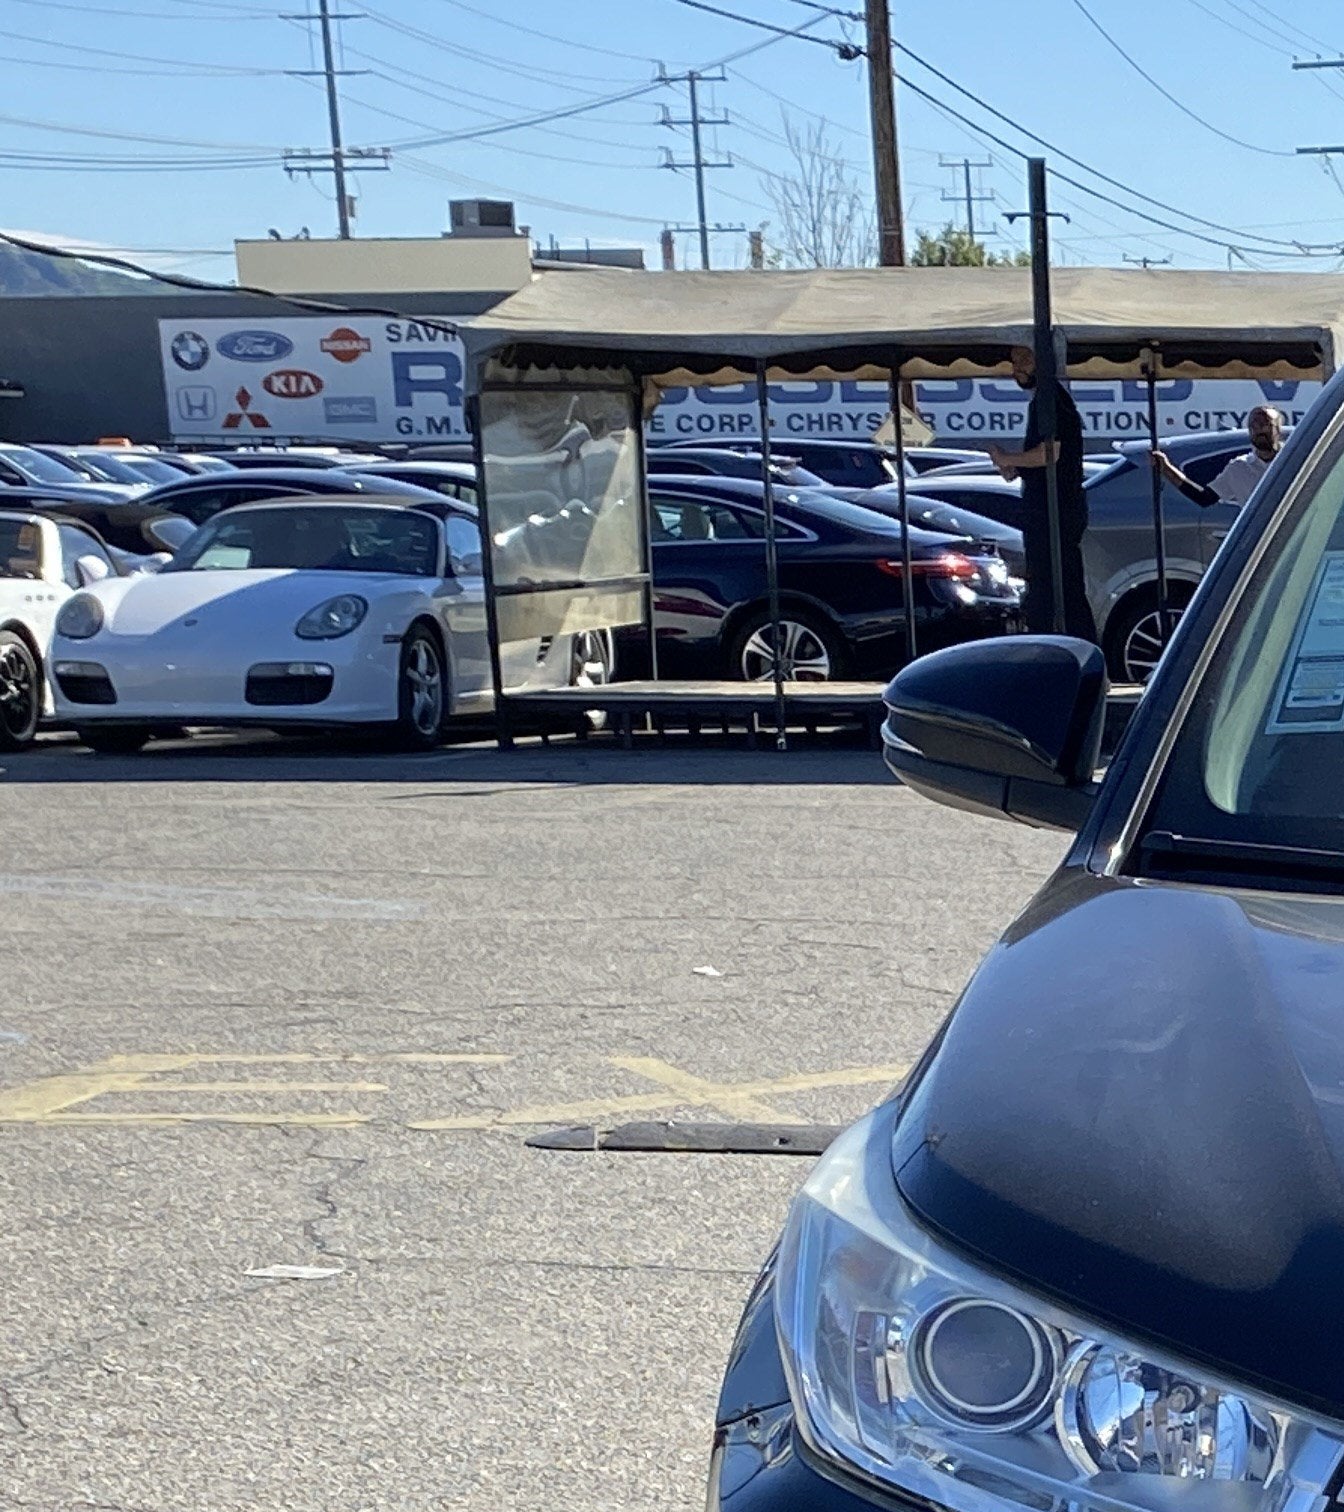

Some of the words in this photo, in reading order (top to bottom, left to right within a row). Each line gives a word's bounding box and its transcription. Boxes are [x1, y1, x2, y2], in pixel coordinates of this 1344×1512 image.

[322, 340, 369, 351] NISSAN
[270, 375, 317, 393] KIA
[675, 412, 758, 433] CORP.
[786, 411, 937, 432] CHRYSR
[946, 410, 1152, 432] CORPTION
[1183, 410, 1249, 430] CITY
